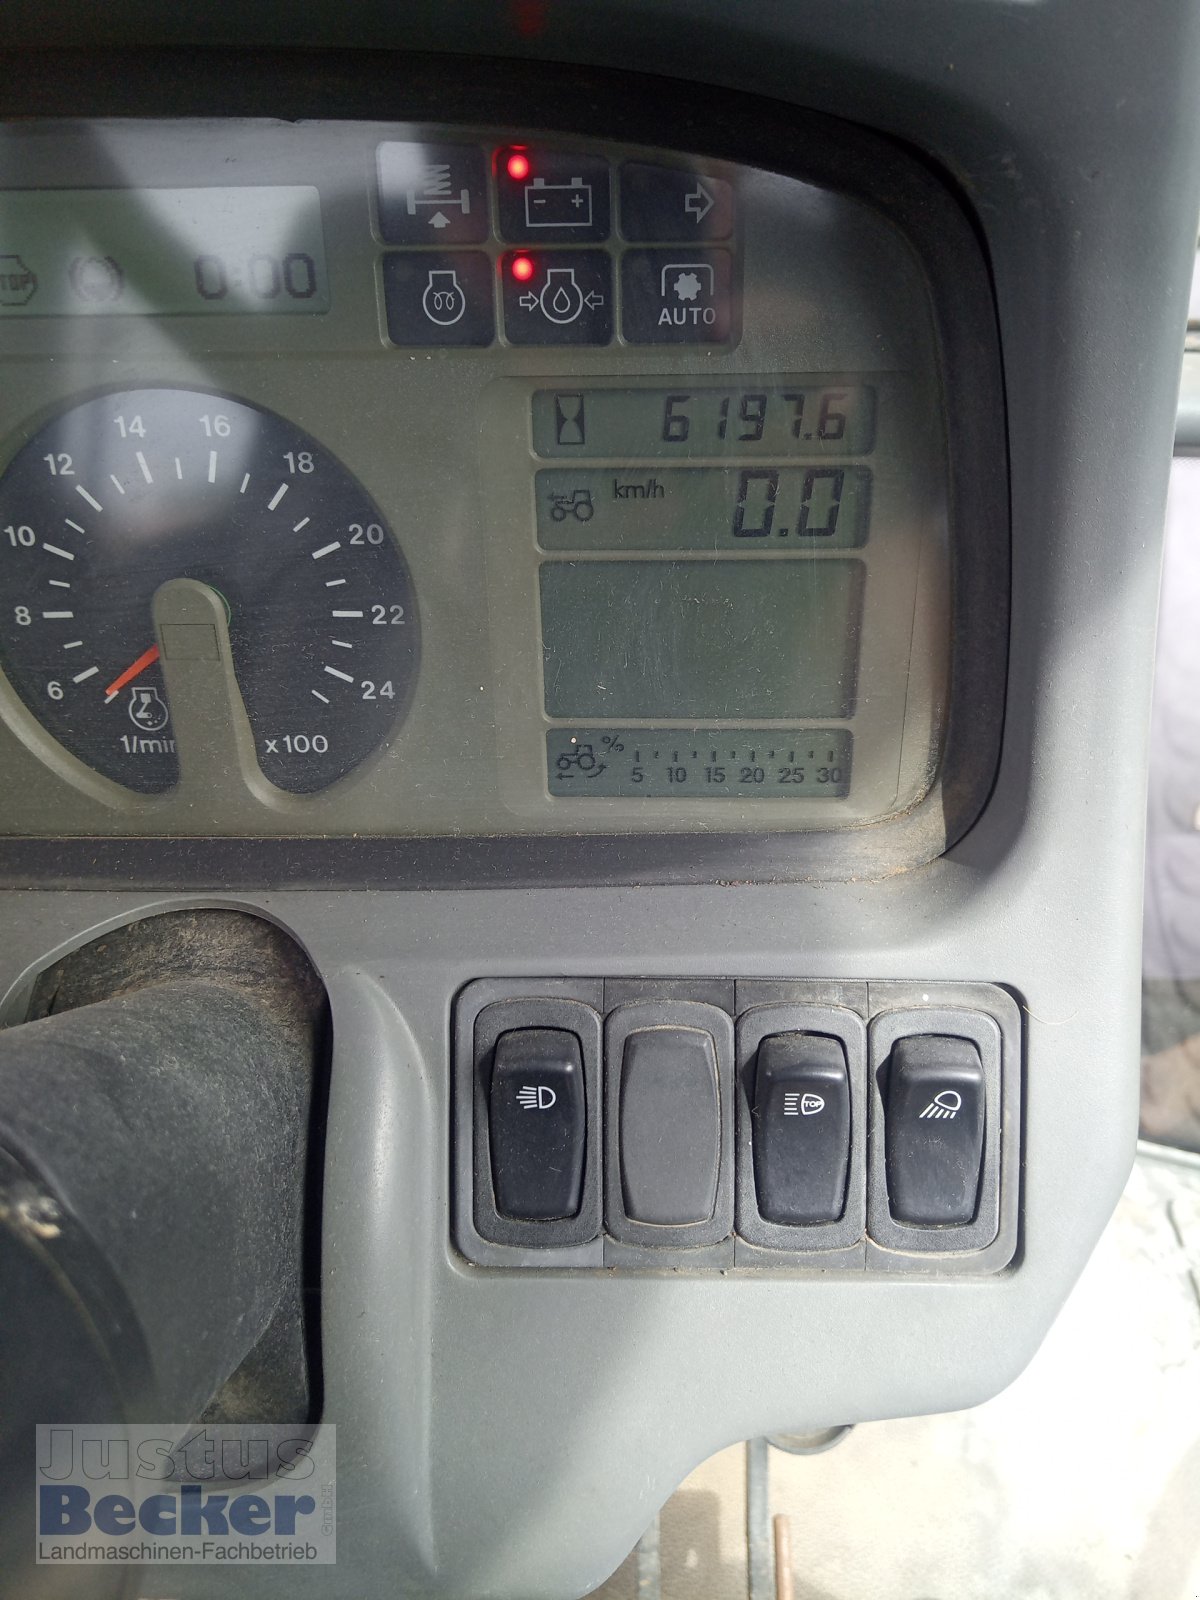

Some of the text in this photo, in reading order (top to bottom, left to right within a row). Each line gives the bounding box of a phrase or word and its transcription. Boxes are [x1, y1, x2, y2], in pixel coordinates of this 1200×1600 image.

[0, 273, 32, 291] TOP
[657, 307, 717, 326] AUTO
[114, 415, 146, 437] 14
[200, 415, 231, 437] 16
[663, 394, 848, 442] 6197.6
[44, 453, 75, 476] 12
[283, 451, 315, 473] 18
[612, 479, 664, 499] km/h
[733, 469, 844, 538] 0.0
[3, 525, 36, 547] 10
[348, 523, 384, 545] 20
[15, 605, 32, 625] 8
[371, 605, 406, 625] 22
[47, 681, 64, 700] 6
[361, 680, 396, 700] 24
[265, 735, 329, 753] x100
[631, 767, 842, 783] 5 10 15 20 25 30
[804, 1100, 822, 1108] TOP
